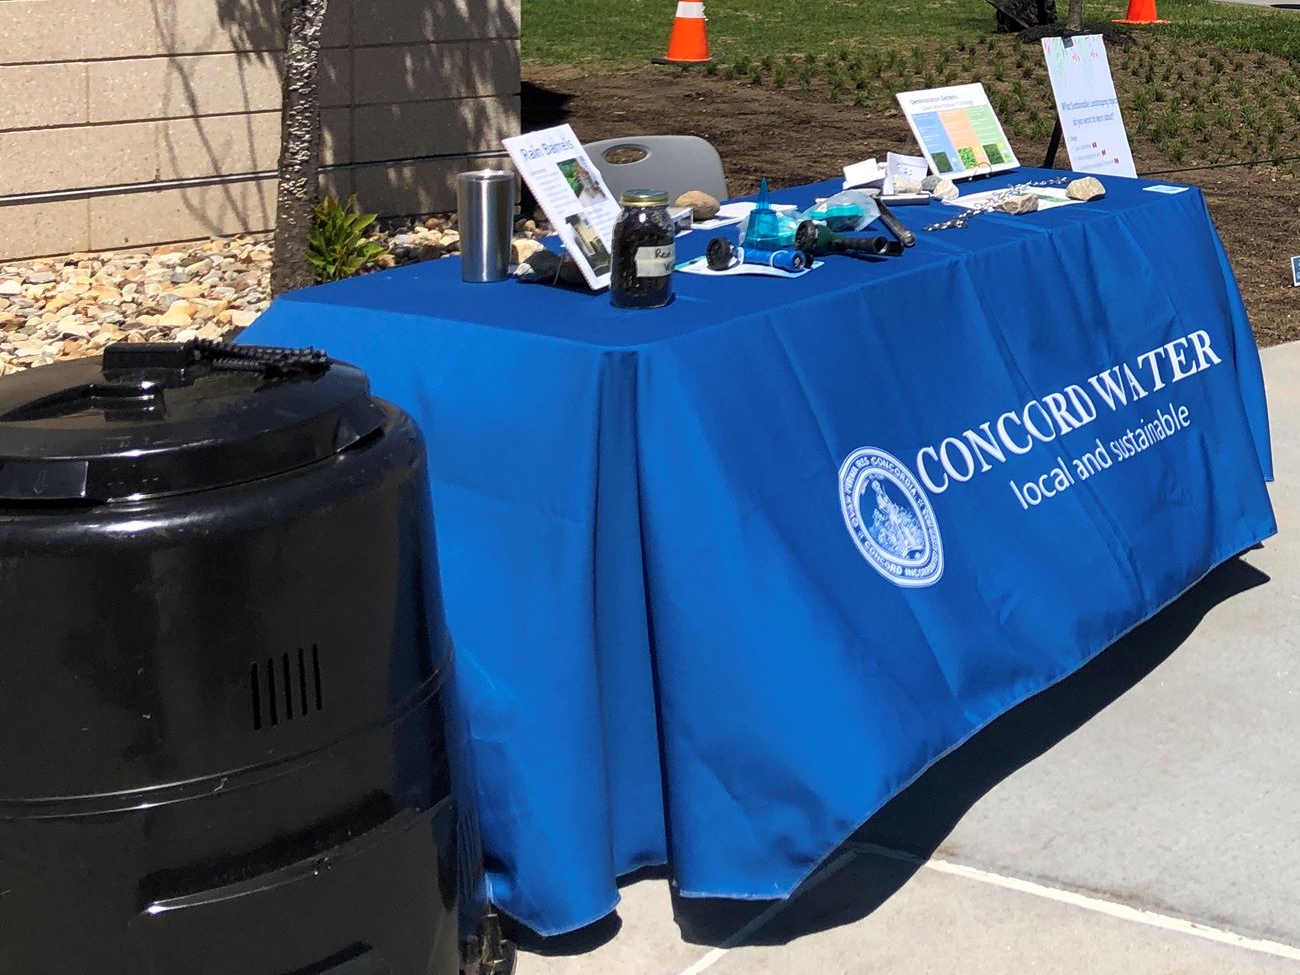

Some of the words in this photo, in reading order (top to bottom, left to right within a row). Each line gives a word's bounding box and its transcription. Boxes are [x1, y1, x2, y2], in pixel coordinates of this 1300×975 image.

[520, 144, 545, 162] Rain
[541, 136, 575, 155] Barrels
[916, 383, 1098, 495] CONCORD
[1088, 329, 1222, 411] WATER
[1009, 456, 1074, 511] local
[1073, 439, 1111, 485] and
[1110, 402, 1192, 462] sustainable
